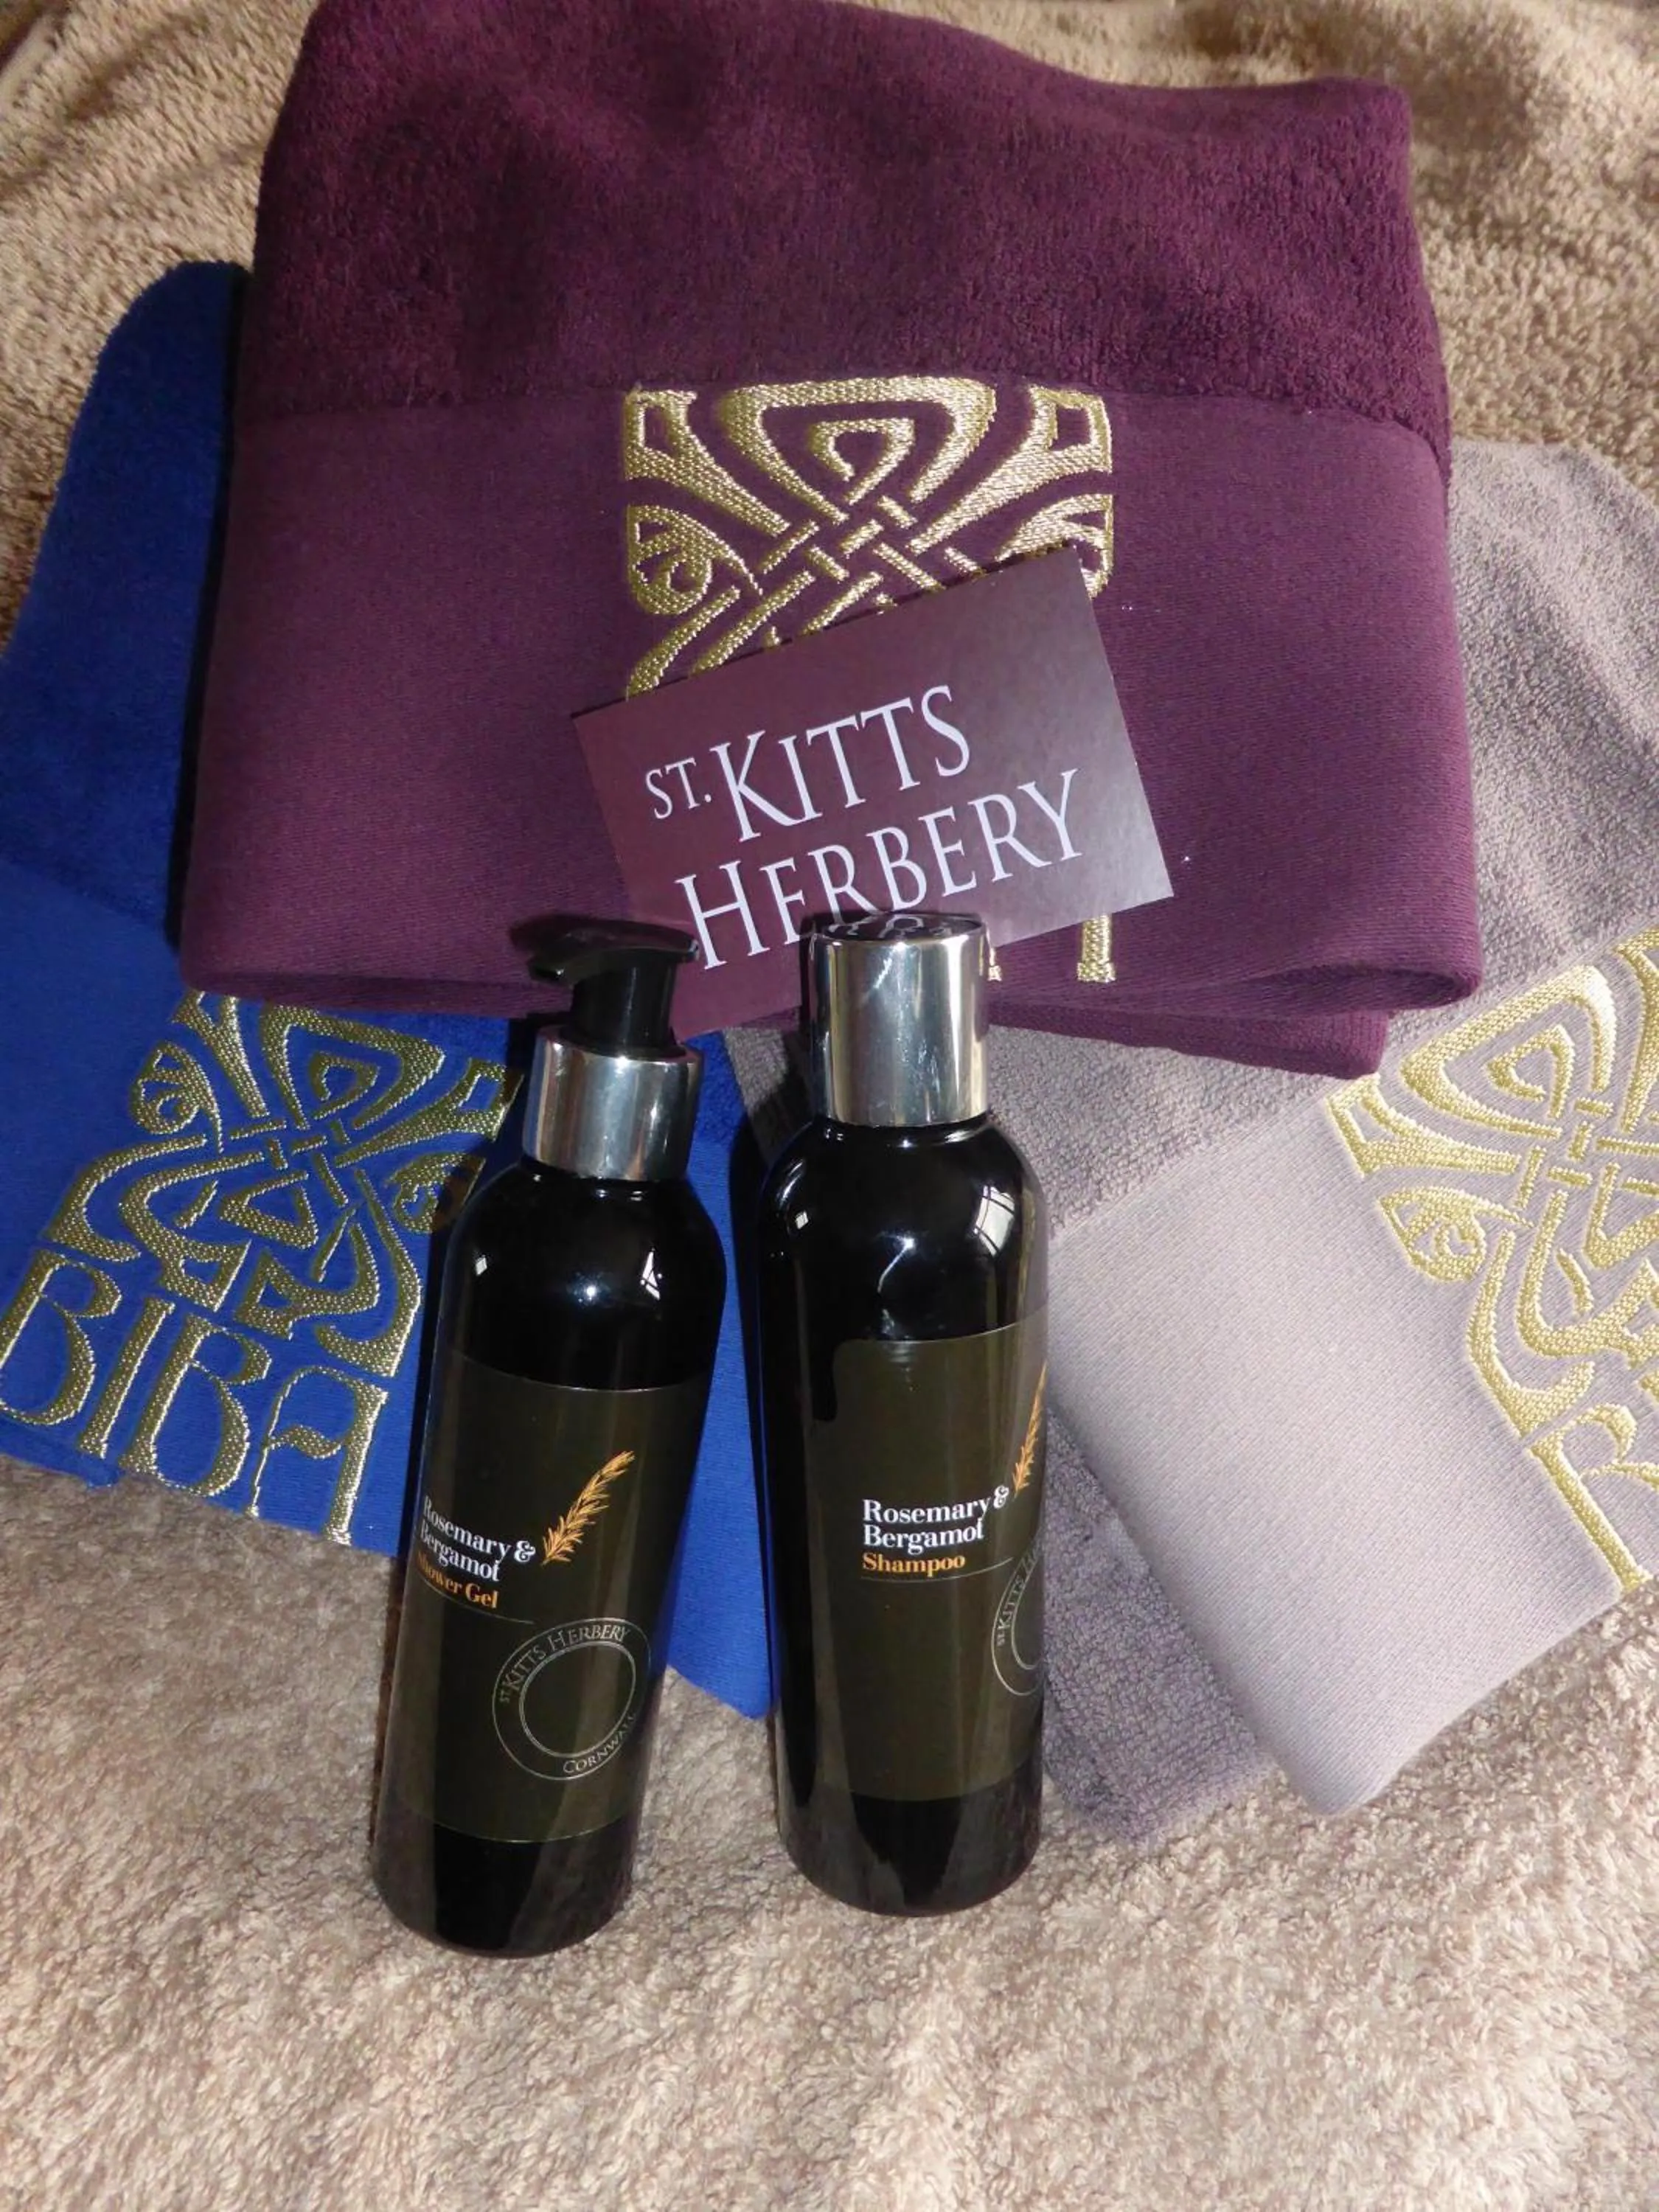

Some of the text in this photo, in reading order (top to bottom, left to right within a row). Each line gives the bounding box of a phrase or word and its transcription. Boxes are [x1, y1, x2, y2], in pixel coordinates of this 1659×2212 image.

[645, 685, 971, 843] ST. KITTS
[674, 768, 1083, 971] HERBERY
[423, 1495, 536, 1564] Rosemary &
[862, 1484, 1010, 1523] Rosemary &
[420, 1519, 501, 1582] Bergamot
[861, 1554, 966, 1576] Shampoo
[863, 1519, 984, 1555] Bergamot
[465, 1582, 498, 1609] Gel
[502, 1644, 547, 1692] KITTS
[546, 1624, 631, 1652] HERBERY
